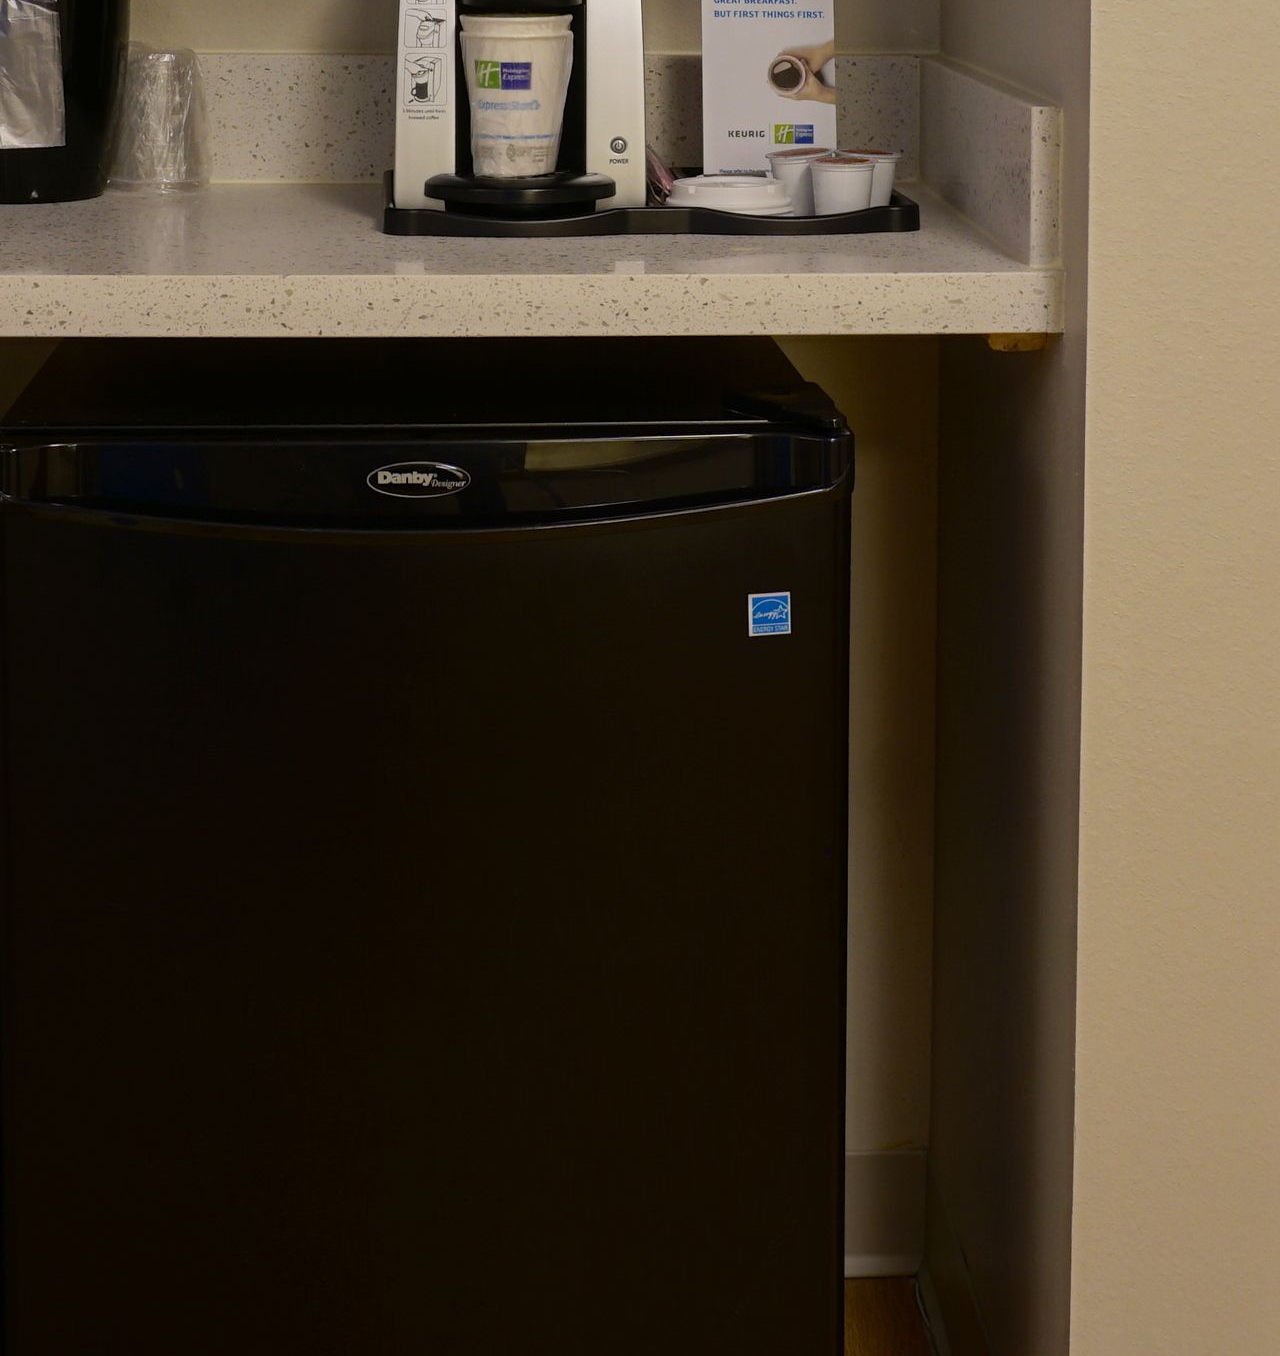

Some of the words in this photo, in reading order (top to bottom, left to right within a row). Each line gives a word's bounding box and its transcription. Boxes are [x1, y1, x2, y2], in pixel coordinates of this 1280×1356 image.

[714, 10, 731, 18] BUT
[733, 10, 760, 18] FIRST
[797, 11, 825, 19] FIRST.
[728, 130, 766, 138] KEURIG
[377, 471, 433, 486] Danby
[432, 479, 466, 489] Designer
